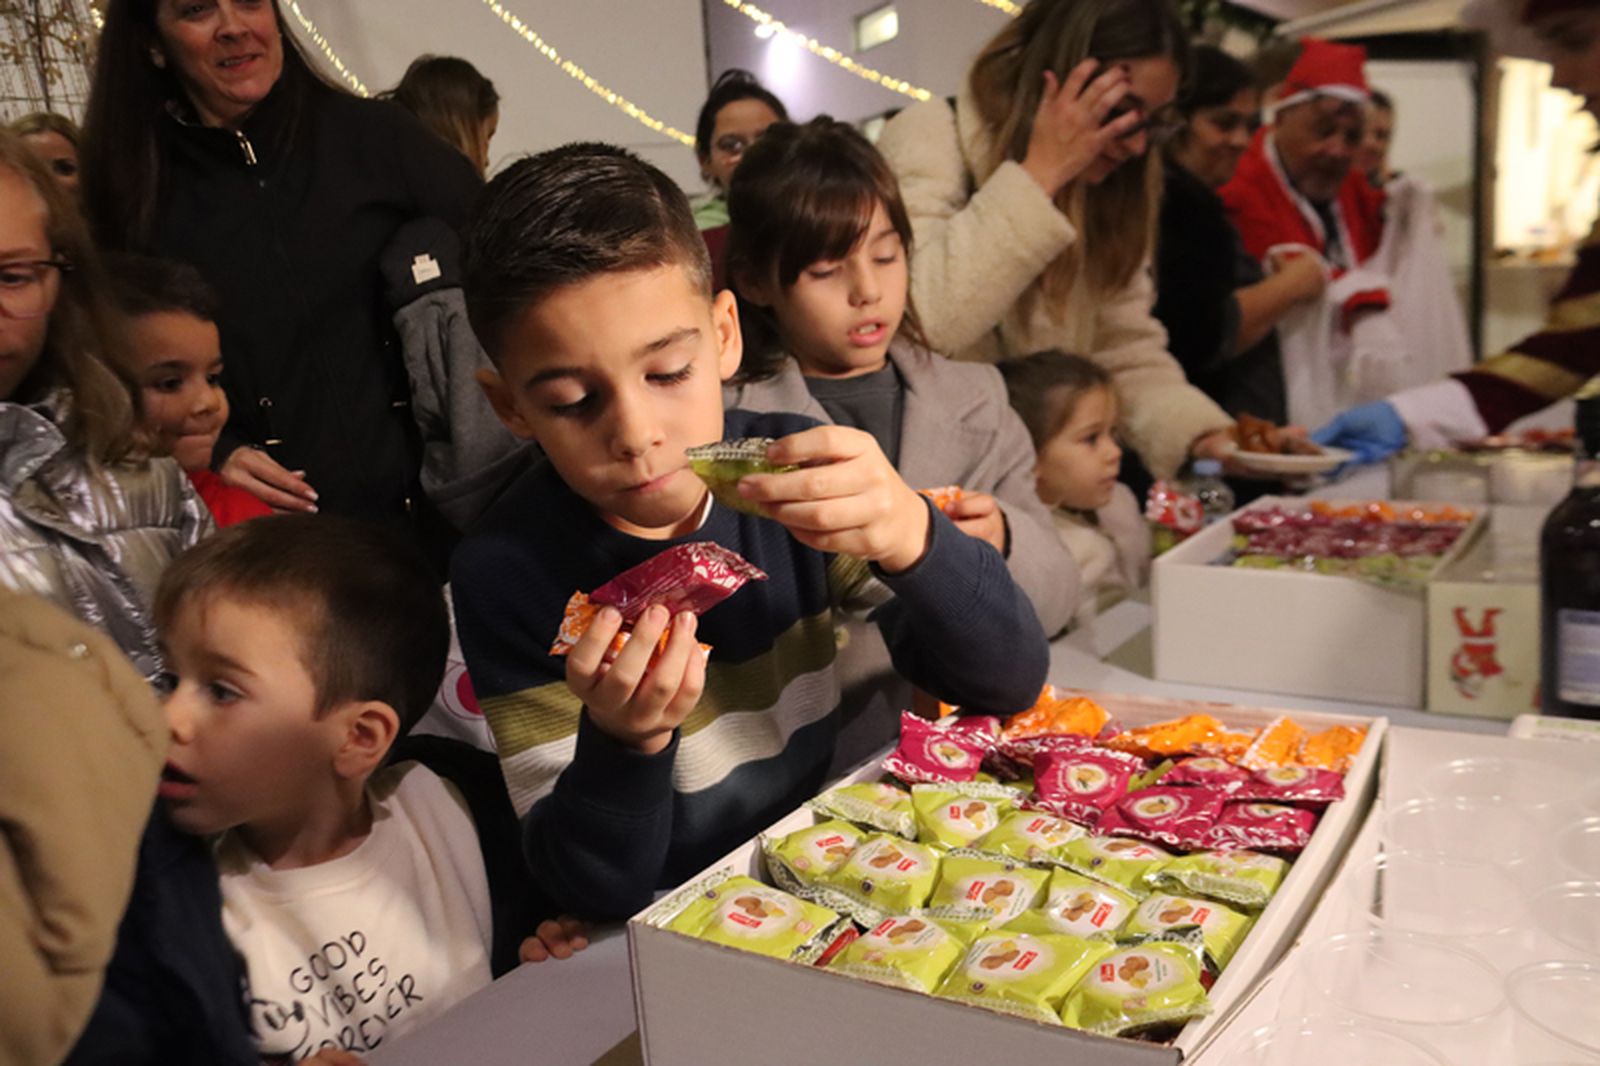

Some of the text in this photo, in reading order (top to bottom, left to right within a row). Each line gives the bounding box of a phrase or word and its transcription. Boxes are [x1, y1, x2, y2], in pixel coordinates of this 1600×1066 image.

[290, 930, 366, 994] GOOD
[308, 957, 388, 1027] VIBES
[301, 973, 423, 1060] REVER
